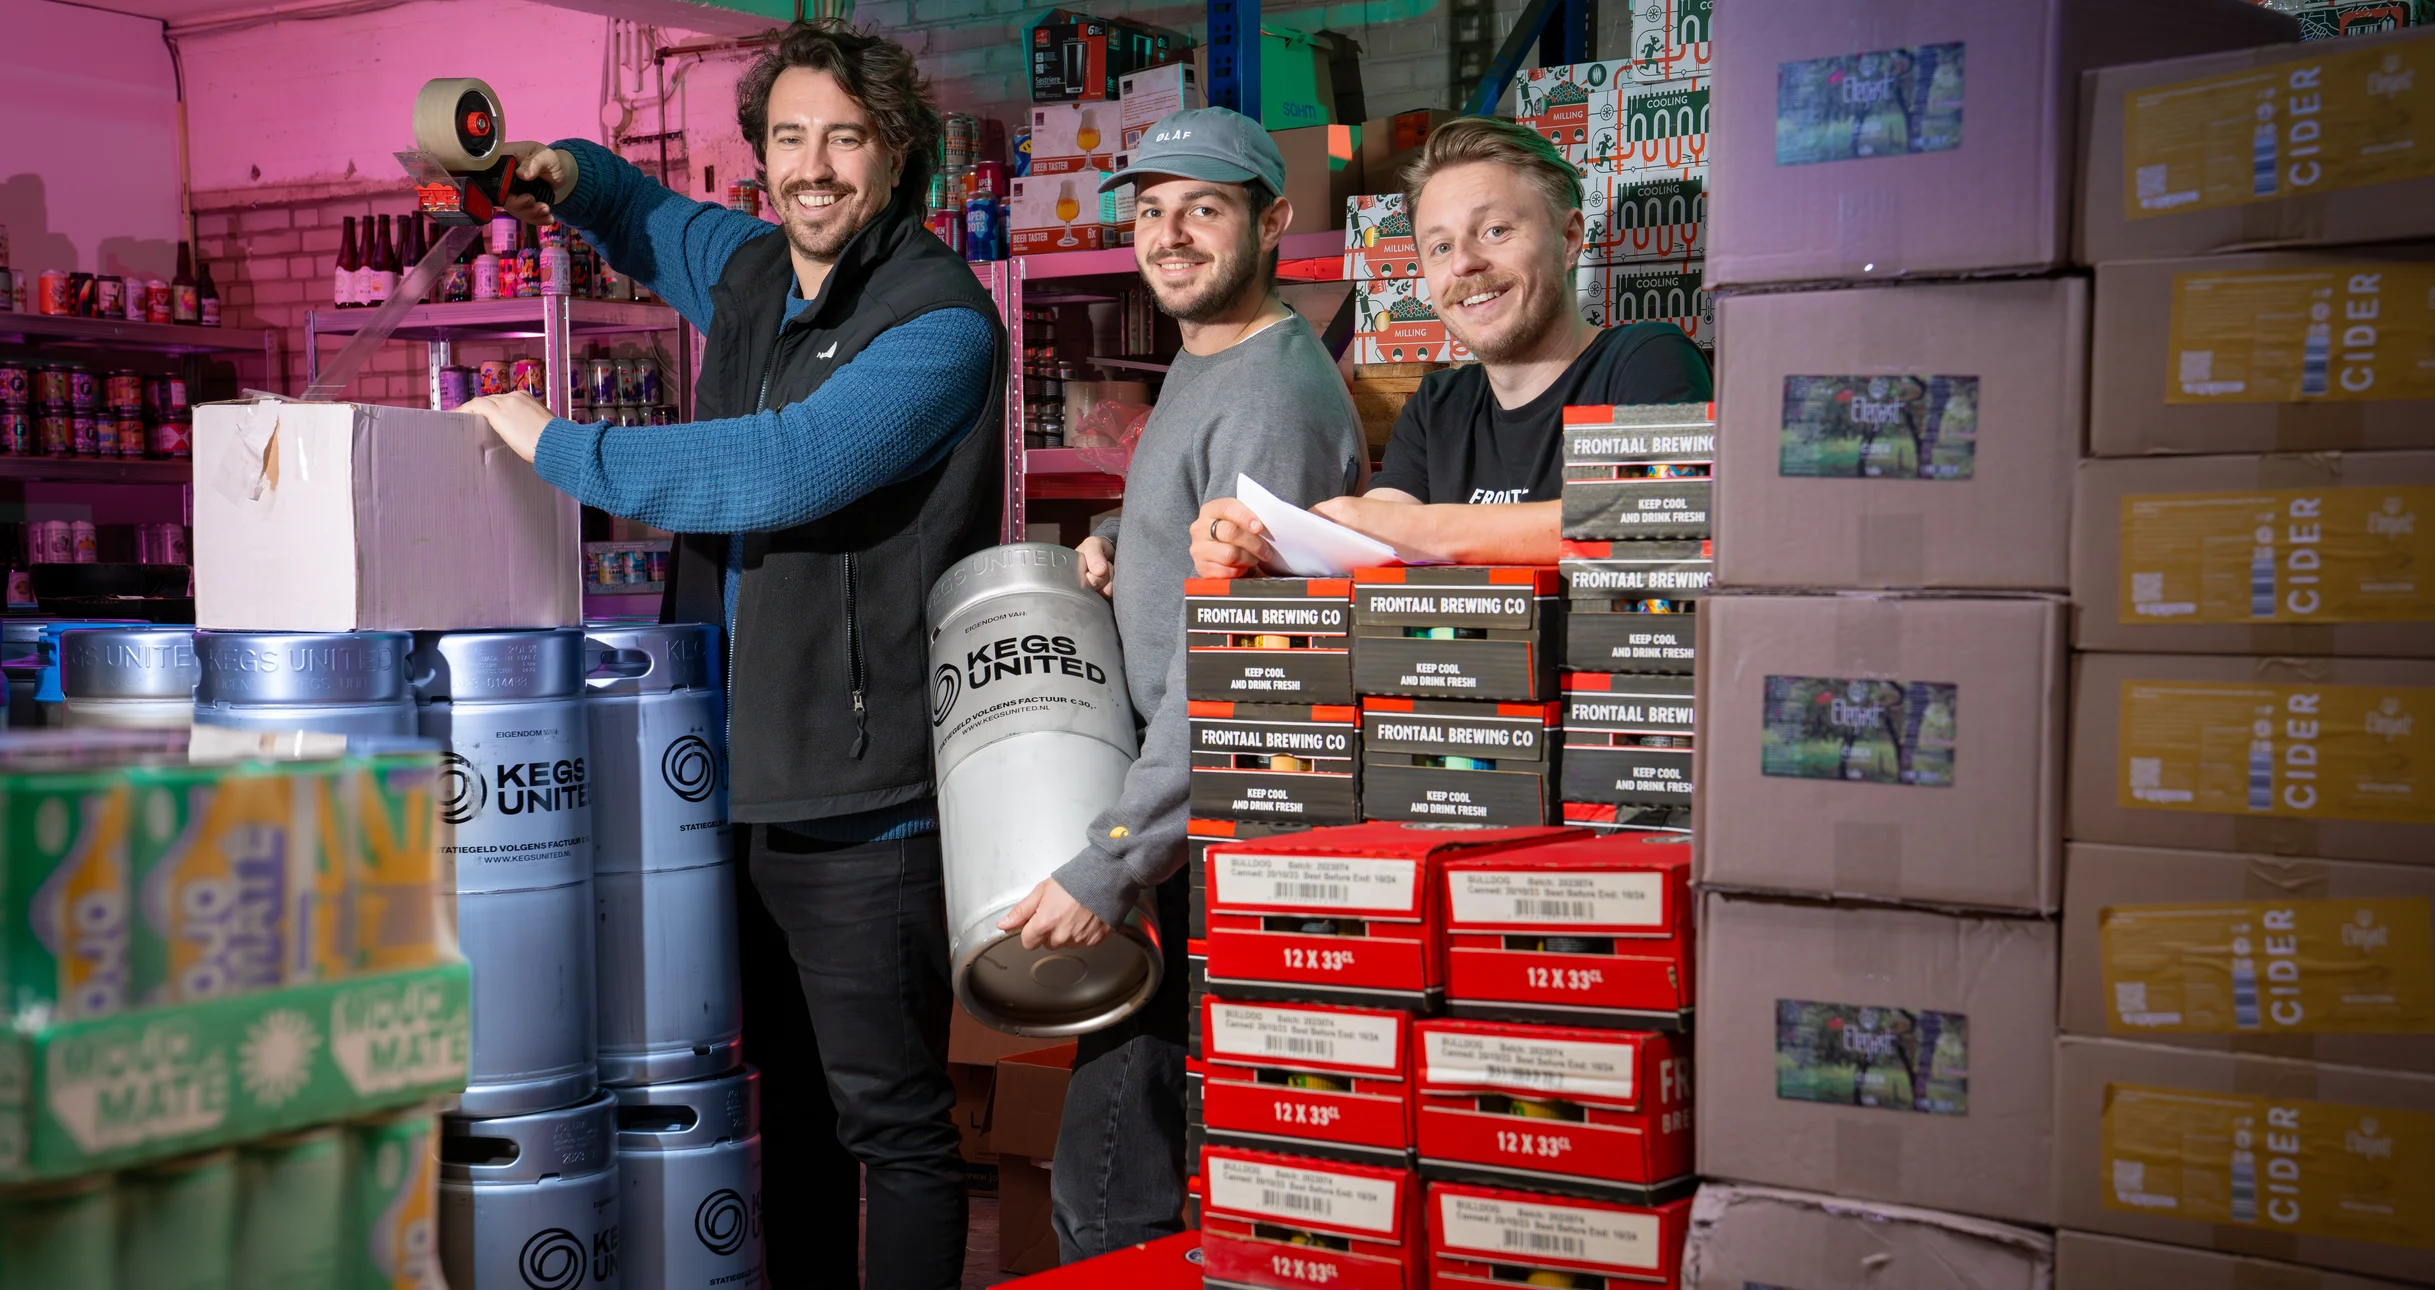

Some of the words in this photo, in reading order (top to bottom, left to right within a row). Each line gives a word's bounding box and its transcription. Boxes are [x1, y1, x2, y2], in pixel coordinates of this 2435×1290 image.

[1088, 25, 1095, 35] 6
[1647, 96, 1688, 109] COOLING
[1553, 111, 1583, 121] MILLING
[2289, 66, 2322, 186] CIDER
[1156, 130, 1192, 143] ØLÅF
[1033, 163, 1048, 171] BEER
[1048, 162, 1068, 170] TASTER
[1636, 183, 1680, 197] COOLING
[967, 211, 985, 221] APEN
[968, 222, 985, 232] ROTS
[1087, 228, 1096, 239] 6x
[1013, 234, 1027, 243] BEER
[1028, 232, 1048, 242] TASTER
[1635, 276, 1679, 289] COOLING
[1395, 329, 1427, 337] MILLING
[2340, 273, 2382, 391] CIDER
[1574, 438, 1646, 454] FRONTAAL
[1639, 499, 1661, 509] KEEP
[1663, 499, 1687, 509] COOL
[1620, 513, 1640, 523] AND
[1642, 512, 1671, 523] DRINK
[1673, 512, 1705, 522] FRESH!
[972, 549, 1067, 575] UNITED
[2287, 498, 2322, 614] CIDER
[1573, 572, 1644, 588] FRONTAAL
[1370, 597, 1436, 612] FRONTAAL
[1441, 597, 1501, 613] BREWING
[1505, 598, 1525, 614] CO
[965, 614, 1007, 633] EIGENDOM
[1198, 608, 1258, 623] FRONTAAL
[1262, 610, 1318, 624] BREWING
[1322, 610, 1340, 625] CO
[1629, 634, 1652, 644] KEEP
[1653, 634, 1677, 645] COOL
[967, 635, 1076, 671] KEGS
[1612, 647, 1631, 658] AND
[1633, 648, 1661, 658] DRINK
[1663, 648, 1694, 658] FRESH!
[208, 647, 279, 673] KEGS
[289, 647, 393, 672] UNITED
[969, 656, 1106, 690] UNITED
[1245, 668, 1263, 677] KEEP
[1265, 668, 1285, 678] COOL
[1417, 663, 1437, 673] KEEP
[1438, 664, 1460, 674] COOL
[1231, 680, 1246, 689] AND
[1248, 680, 1272, 690] DRINK
[1274, 681, 1300, 690] FRESH!
[1401, 675, 1418, 686] AND
[1420, 676, 1445, 687] DRINK
[1447, 677, 1476, 688] FRESH!
[972, 699, 1017, 719] VOLGENS
[1018, 696, 1067, 705] FACTUUR
[1572, 704, 1644, 722] FRONTAAL
[962, 705, 1050, 735] WWW.KEGSUNITED.NL
[1202, 730, 1262, 747] FRONTAAL
[1266, 733, 1322, 749] BREWING
[1326, 734, 1345, 750] CO
[1378, 724, 1444, 742] FRONTAAL
[1449, 727, 1509, 745] BREWING
[1512, 730, 1533, 747] CO
[2284, 693, 2320, 809] CIDER
[497, 757, 585, 789] KEGS
[1633, 767, 1656, 778] KEEP
[1657, 768, 1681, 779] COOL
[1616, 780, 1635, 790] AND
[1636, 781, 1665, 792] DRINK
[1247, 788, 1266, 798] KEEP
[1268, 789, 1288, 799] COOL
[1426, 791, 1447, 801] KEEP
[1449, 792, 1471, 803] COOL
[1232, 800, 1248, 810] AND
[1250, 801, 1274, 811] DRINK
[1276, 802, 1303, 812] FRESH!
[1411, 803, 1428, 813] AND
[1430, 804, 1456, 815] DRINK
[1458, 805, 1487, 817] FRESH!
[437, 845, 498, 854] TATIEGELD
[499, 842, 546, 853] VOLGENS
[548, 837, 581, 849] FACTUUR
[484, 851, 572, 864] WWW.KEGSUNITED.NL
[1231, 859, 1271, 868] BULLDOG
[1231, 869, 1263, 878] Canned:
[1304, 872, 1322, 881] Best
[1325, 873, 1350, 881] Before
[1467, 876, 1511, 885] BULLDOG
[1284, 948, 1303, 968] 12
[1307, 951, 1319, 969] X
[2264, 909, 2303, 1026] CIDER
[1527, 967, 1548, 988] 12
[1552, 969, 1564, 988] X
[1274, 1102, 1292, 1121] 12
[1296, 1104, 1306, 1123] X
[1498, 1131, 1517, 1151] 12
[1521, 1134, 1534, 1154] X
[2267, 1107, 2301, 1224] CIDER
[1272, 1256, 1291, 1277] 12
[1294, 1260, 1304, 1279] X
